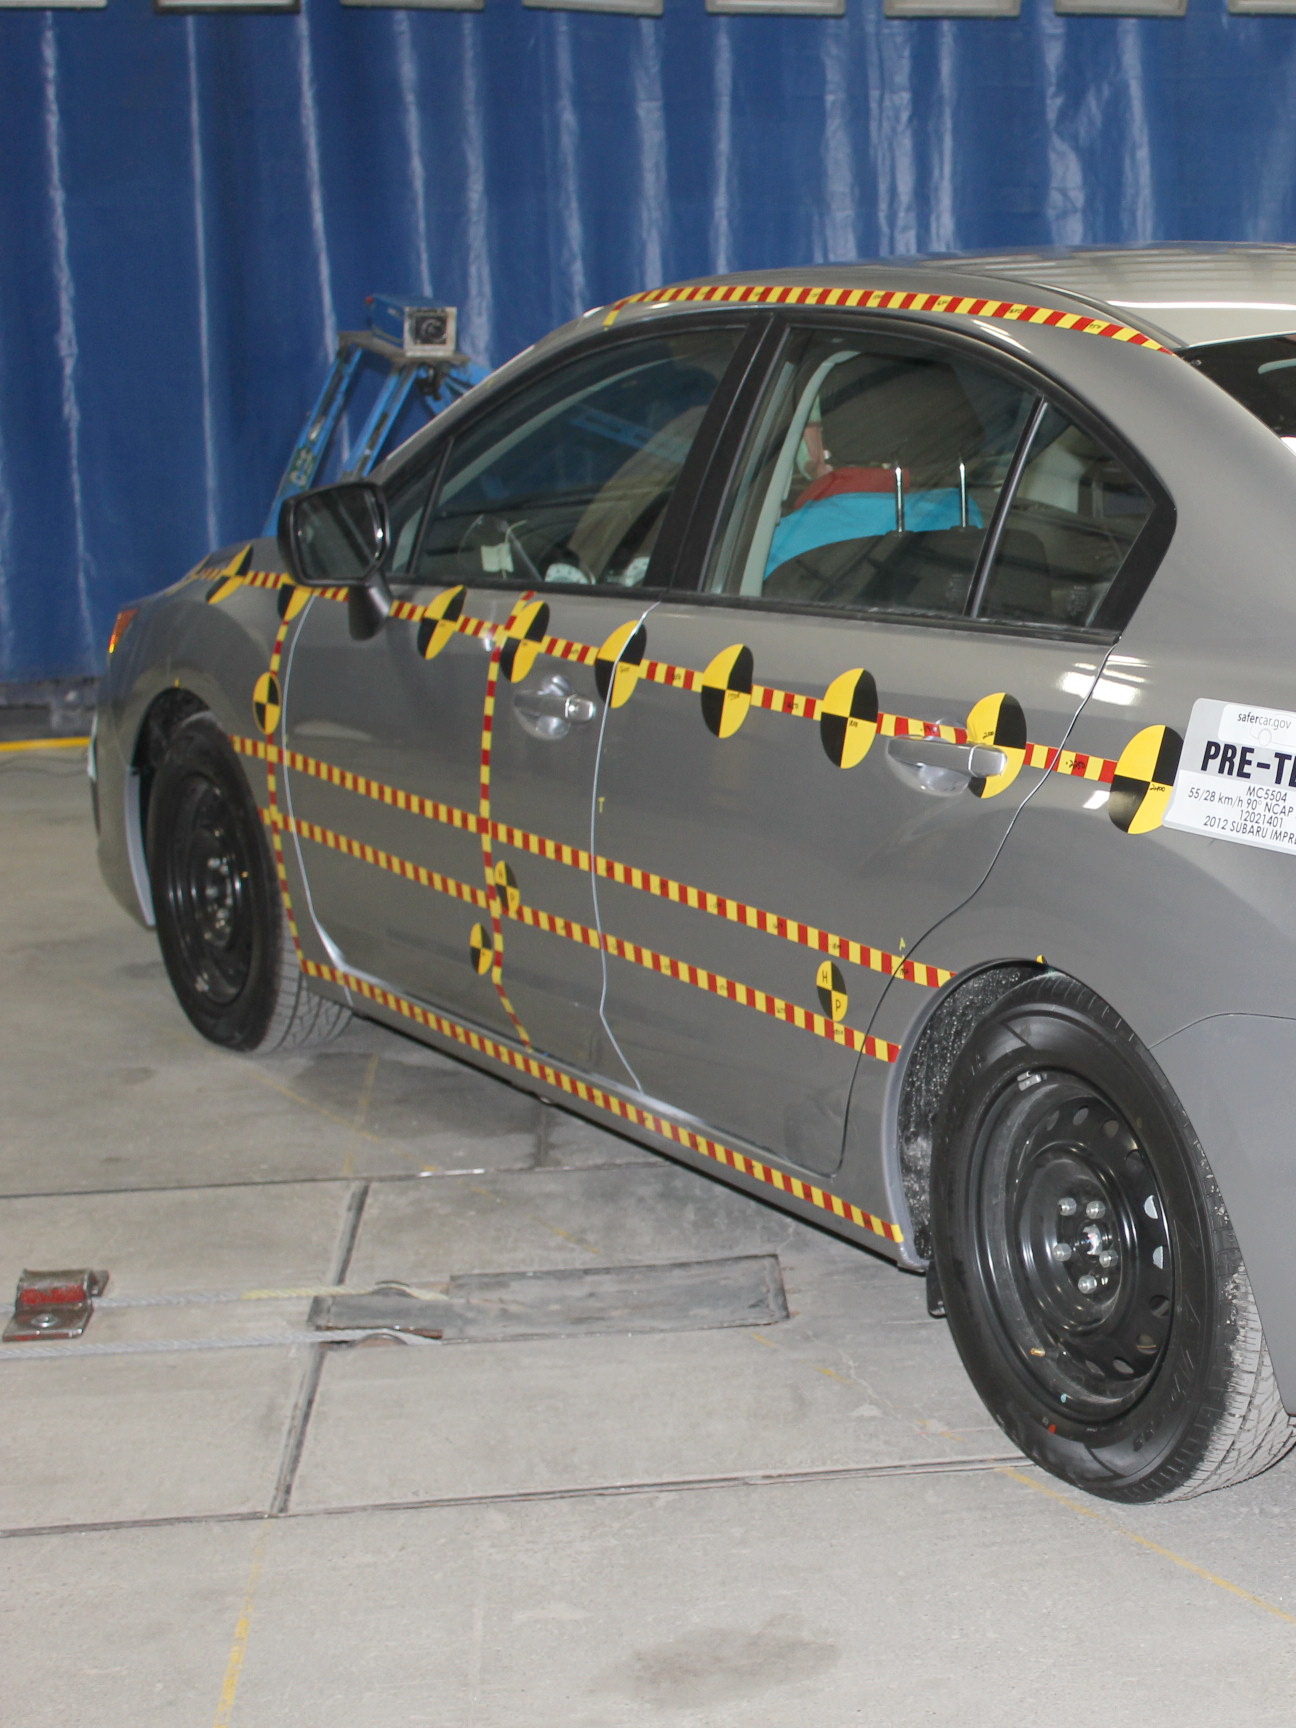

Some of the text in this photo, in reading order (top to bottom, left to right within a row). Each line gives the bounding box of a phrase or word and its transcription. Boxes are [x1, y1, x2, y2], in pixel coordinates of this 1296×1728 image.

[1237, 711, 1292, 731] safercar.gov
[1188, 787, 1216, 803] 55/28
[1218, 792, 1243, 808] km/h
[1264, 801, 1294, 817] NCAP
[1246, 785, 1288, 803] MC5504
[1203, 815, 1229, 831] 2012
[1230, 820, 1269, 839] SUBARU
[1240, 809, 1284, 829] 12021401
